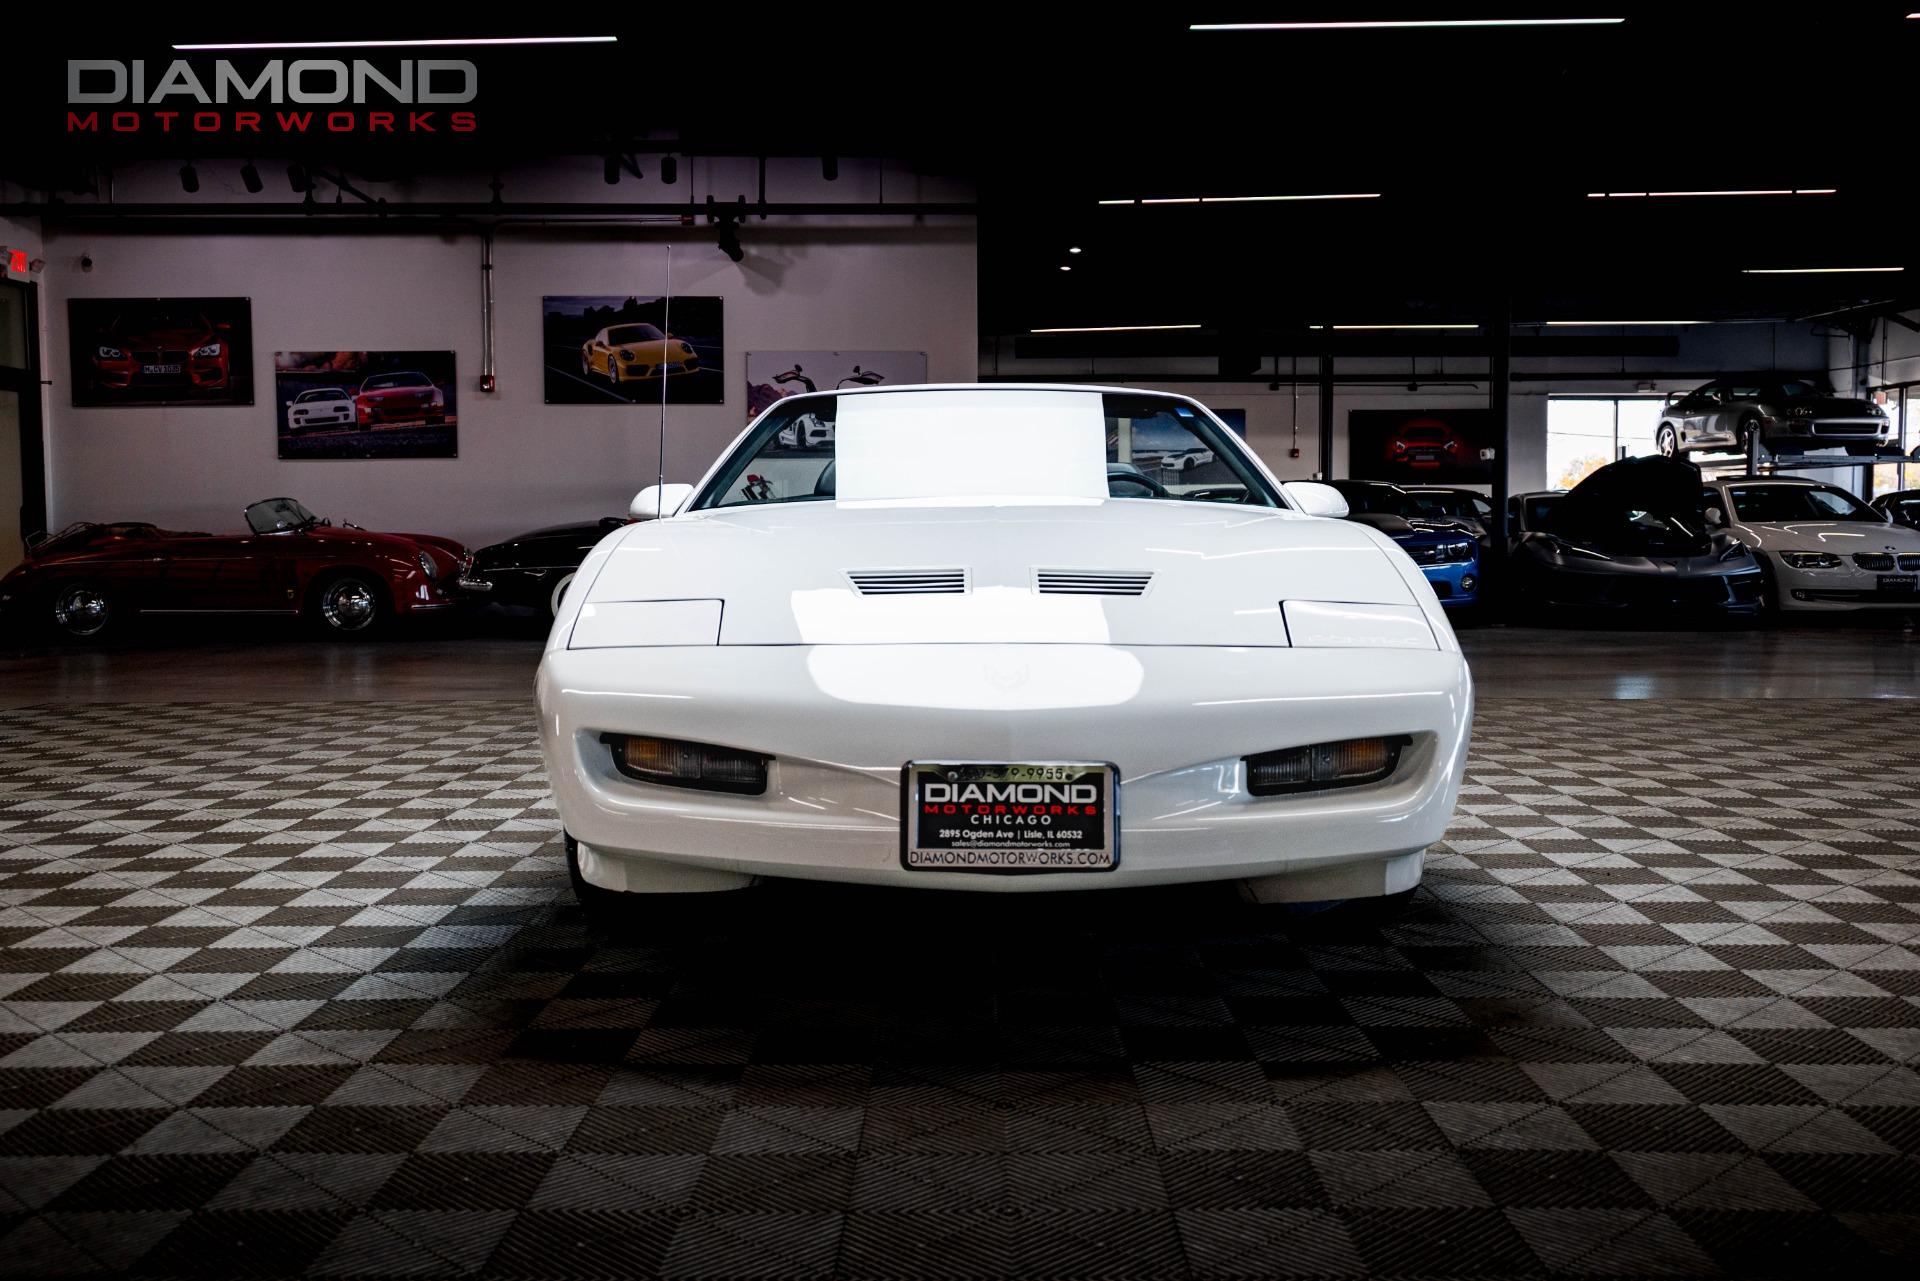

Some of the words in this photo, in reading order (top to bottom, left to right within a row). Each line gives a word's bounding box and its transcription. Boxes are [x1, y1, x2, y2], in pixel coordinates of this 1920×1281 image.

[924, 783, 1098, 804] DIAMOND
[923, 804, 1098, 815] MOTORWORKS
[970, 814, 1052, 825] CHICAGO
[938, 829, 961, 839] 2895
[962, 829, 994, 840] Ogden
[996, 829, 1015, 839] Ave
[1023, 830, 1045, 840] Lisle,
[1047, 830, 1055, 839] IL
[1056, 830, 1083, 839] 60532
[951, 840, 1071, 848] sales@diamondmotorworks.com
[909, 851, 1112, 865] DIAMONDMOTORWORKS.COM
